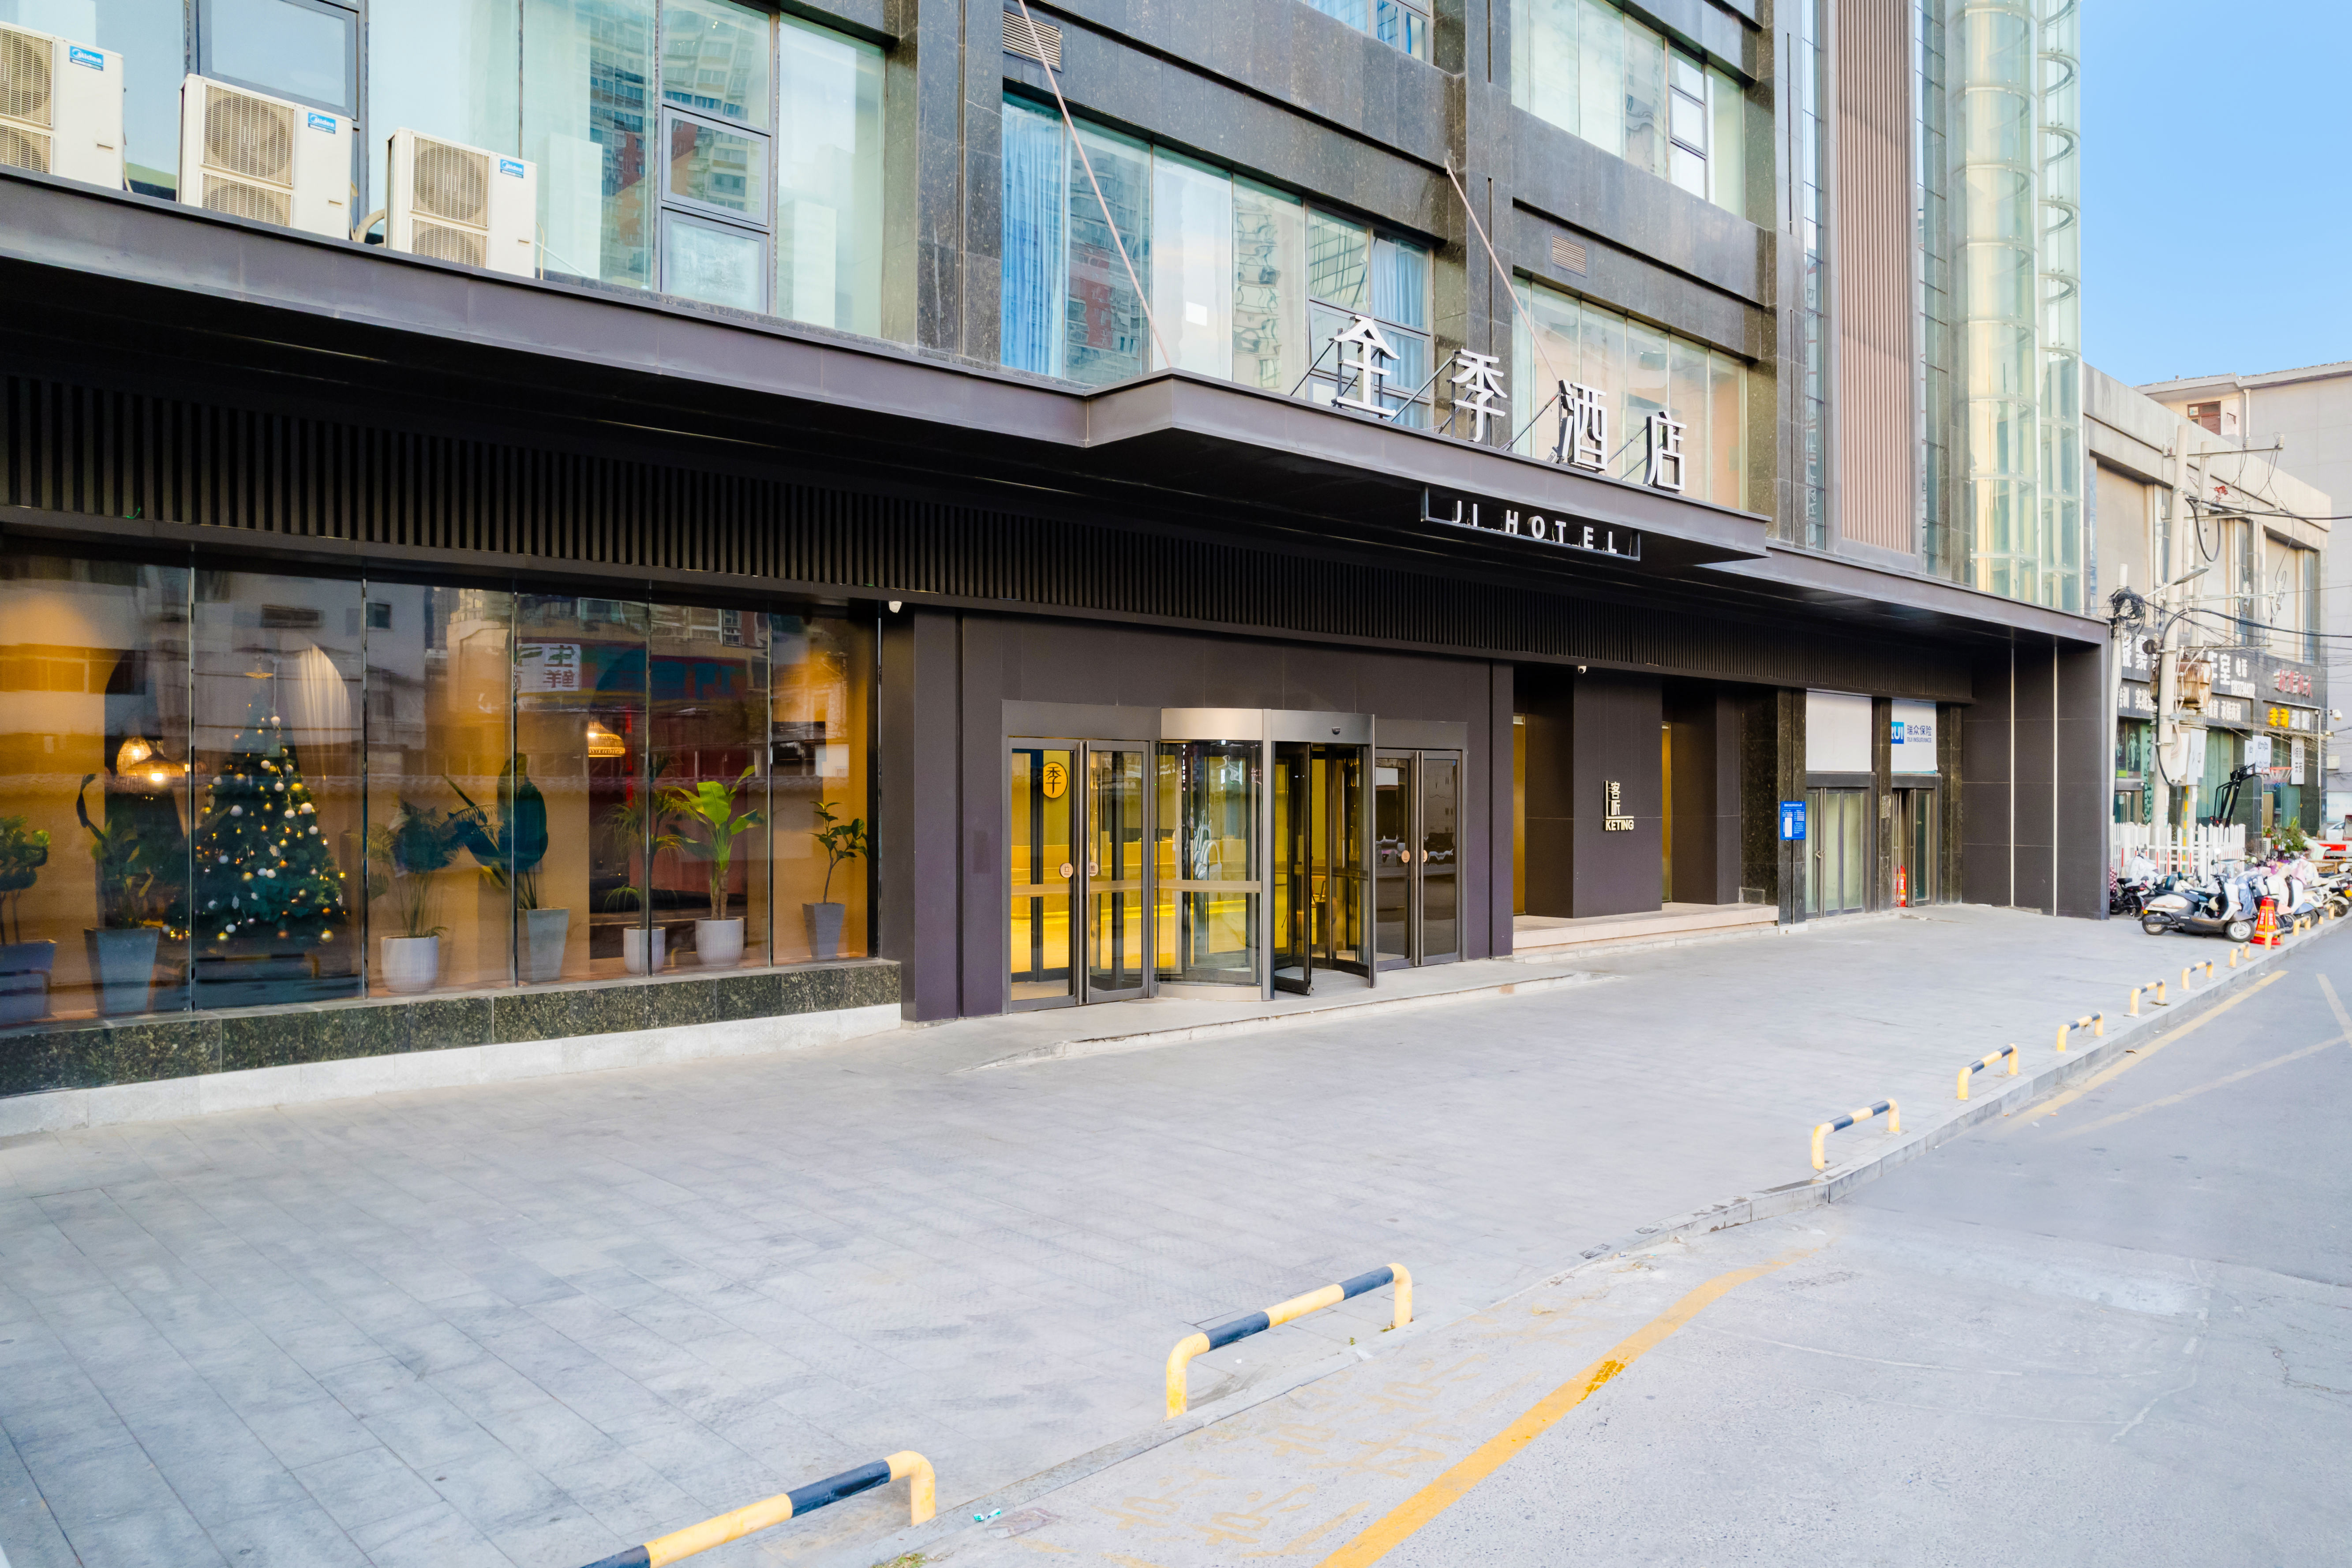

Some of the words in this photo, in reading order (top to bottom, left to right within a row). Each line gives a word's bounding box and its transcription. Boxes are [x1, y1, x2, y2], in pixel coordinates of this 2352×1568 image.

[73, 49, 102, 63] Midea
[311, 116, 334, 127] Midea
[1332, 314, 1687, 490] 全季酒店
[1453, 500, 1478, 527] JI
[1505, 509, 1617, 554] HOTEL
[2235, 658, 2248, 678] 电话
[1907, 725, 1932, 736] 瑞众保险
[1045, 766, 1062, 795] 季
[1606, 819, 1634, 831] KETING
